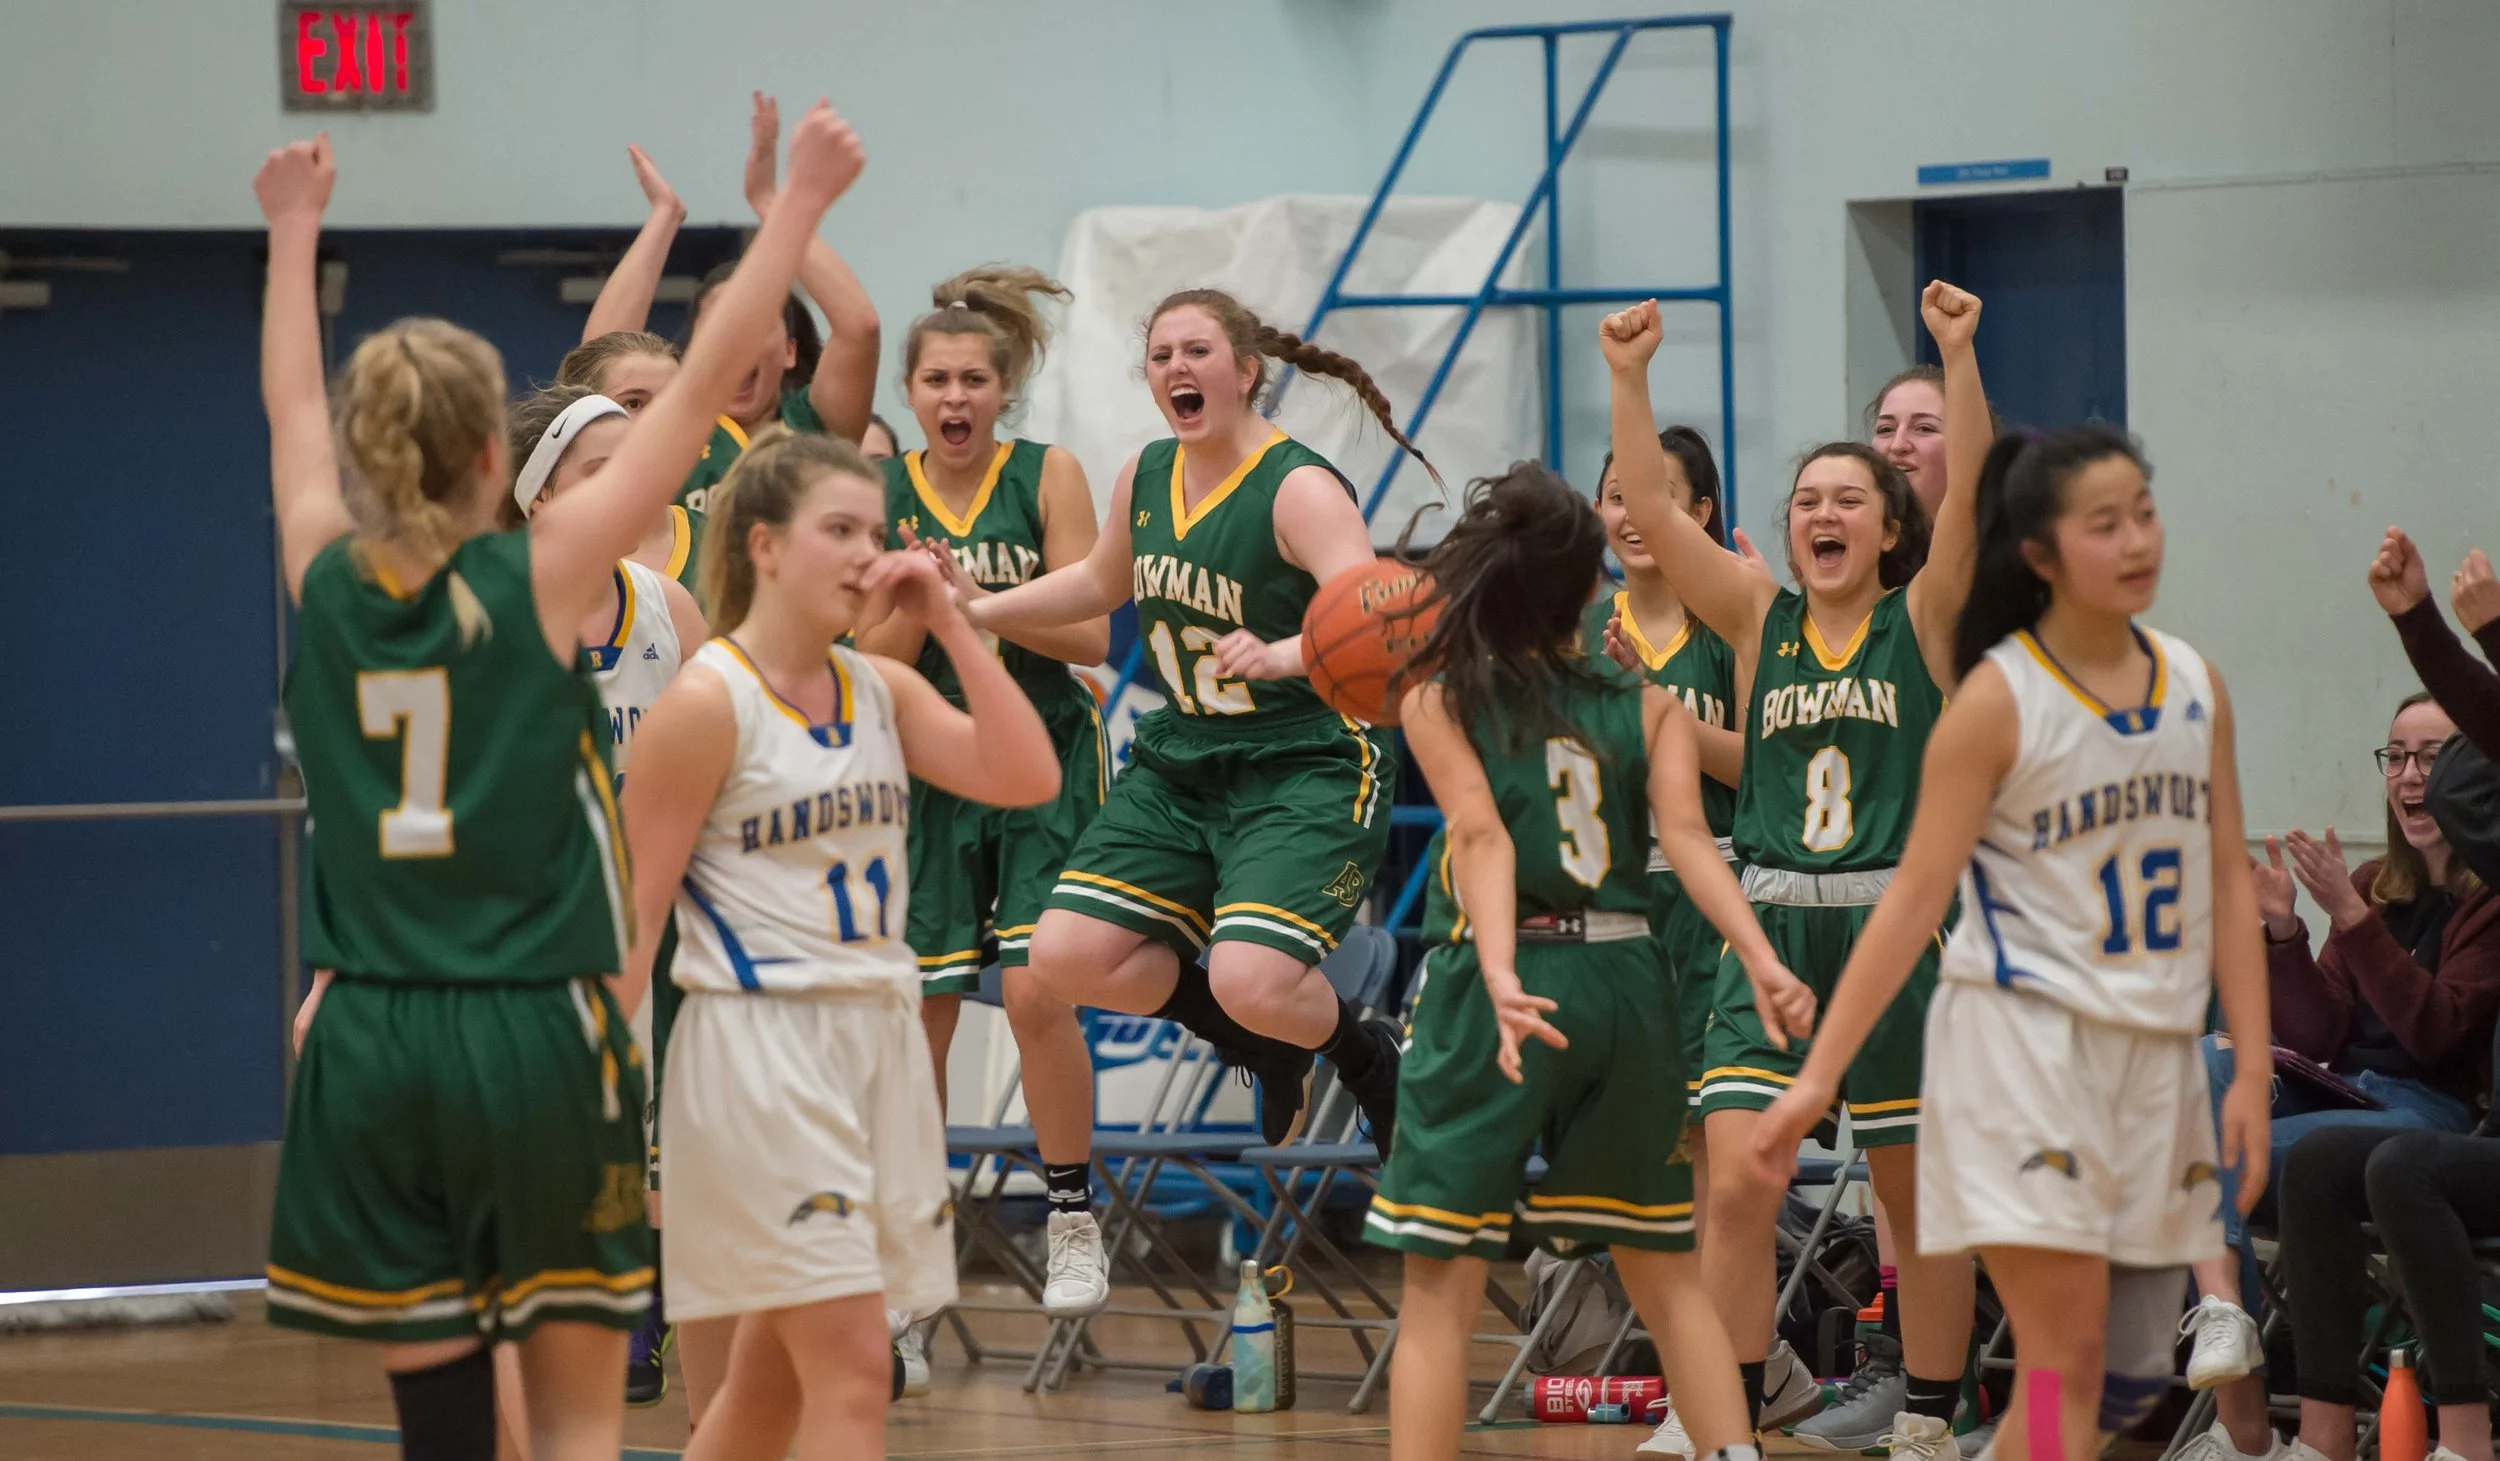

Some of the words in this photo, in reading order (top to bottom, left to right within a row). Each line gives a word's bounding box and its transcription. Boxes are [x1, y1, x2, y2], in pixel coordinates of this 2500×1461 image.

[296, 12, 413, 93] EXIT
[1133, 554, 1244, 626] OWMAN
[1149, 620, 1256, 716] 12
[1762, 677, 1899, 740] BOWMAN
[356, 665, 455, 860] 7
[1802, 745, 1854, 853] 8
[1546, 736, 1612, 889] 3
[819, 853, 893, 944] 11
[2094, 845, 2185, 957] 12
[1546, 1378, 1565, 1414] BIO
[1564, 1378, 1575, 1413] STEEL
